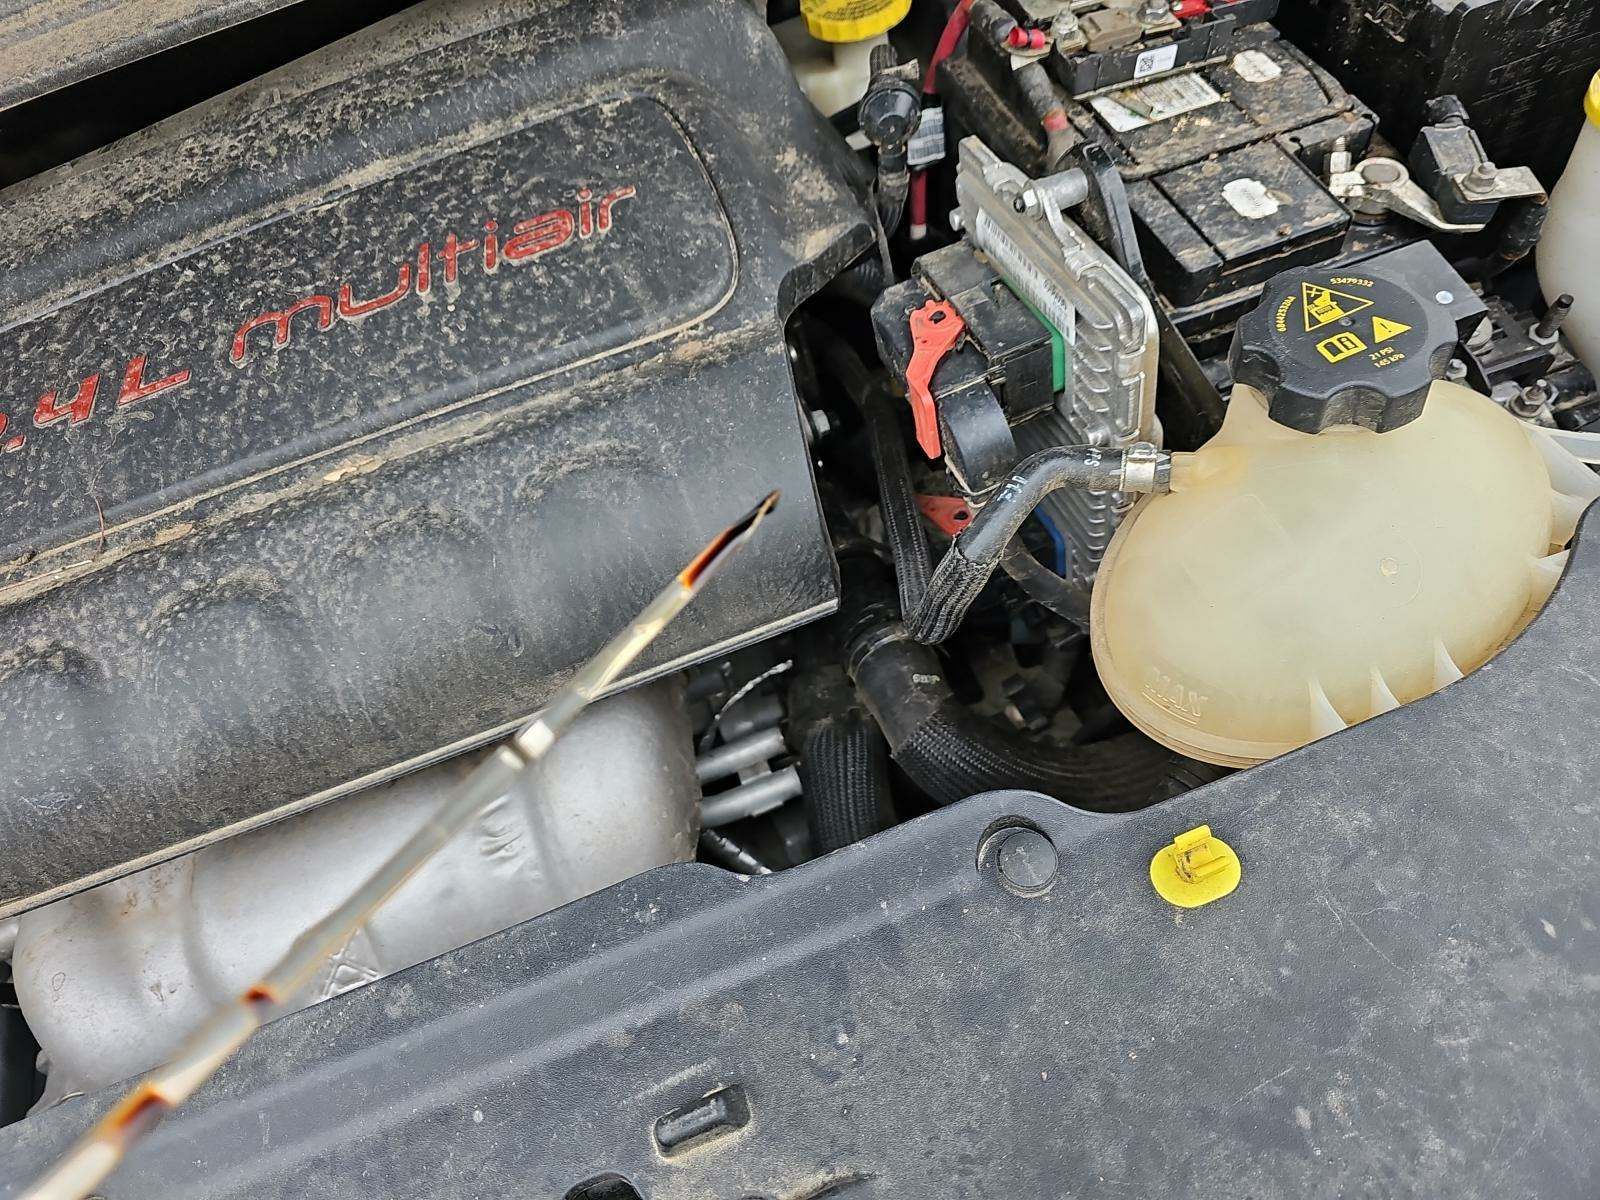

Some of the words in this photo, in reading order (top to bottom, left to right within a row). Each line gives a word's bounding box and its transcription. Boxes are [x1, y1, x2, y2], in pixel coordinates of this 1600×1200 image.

[0, 352, 190, 452] .4L
[230, 185, 636, 362] multiair
[1368, 352, 1381, 361] 21
[1379, 346, 1395, 356] PSI
